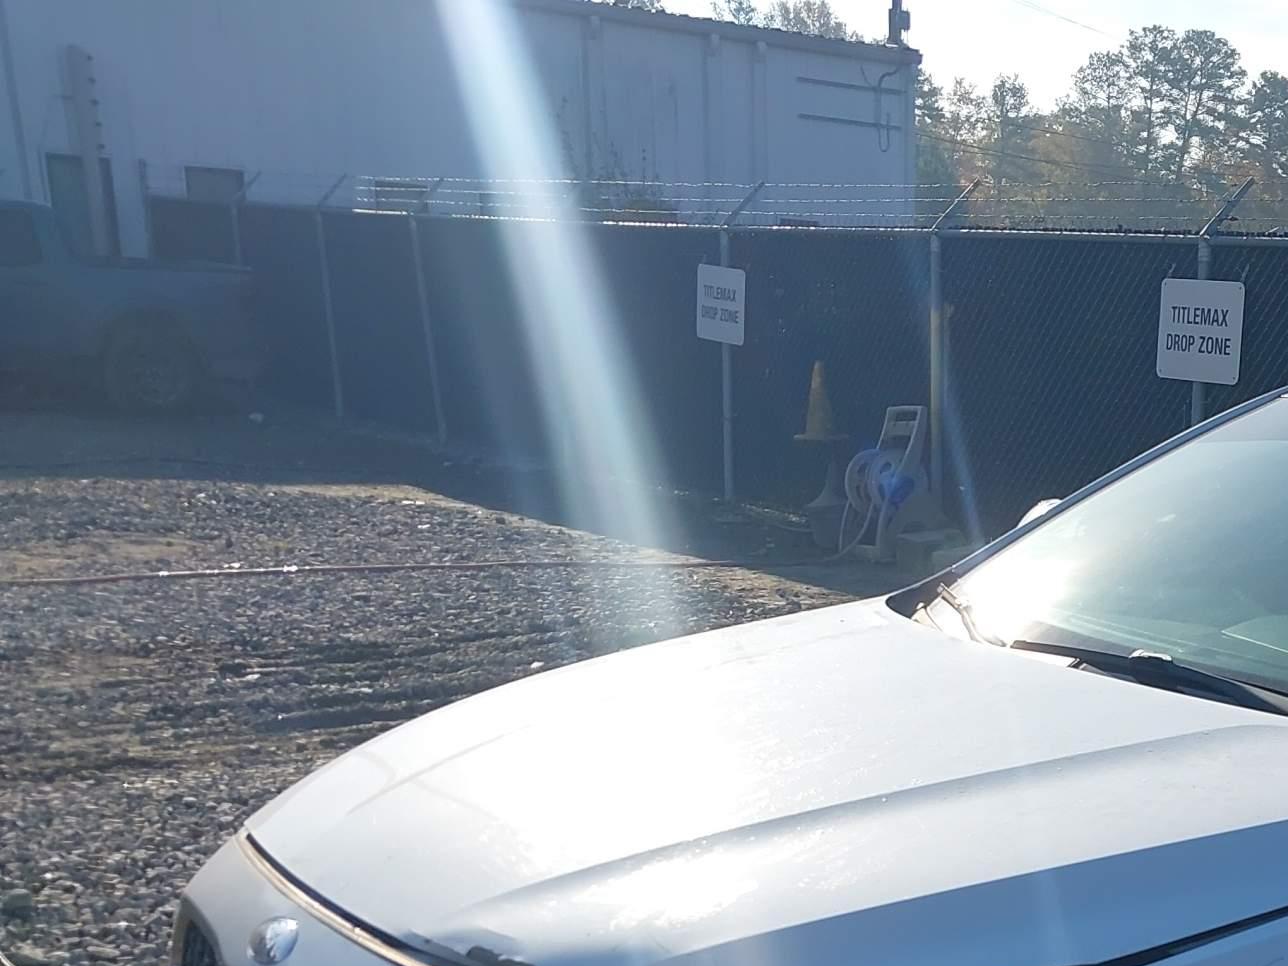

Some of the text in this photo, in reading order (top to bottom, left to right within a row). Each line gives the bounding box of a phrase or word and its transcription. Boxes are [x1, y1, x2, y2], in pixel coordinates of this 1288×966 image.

[1171, 305, 1229, 328] TITLEMAX
[1166, 333, 1231, 356] DROP ZONE
